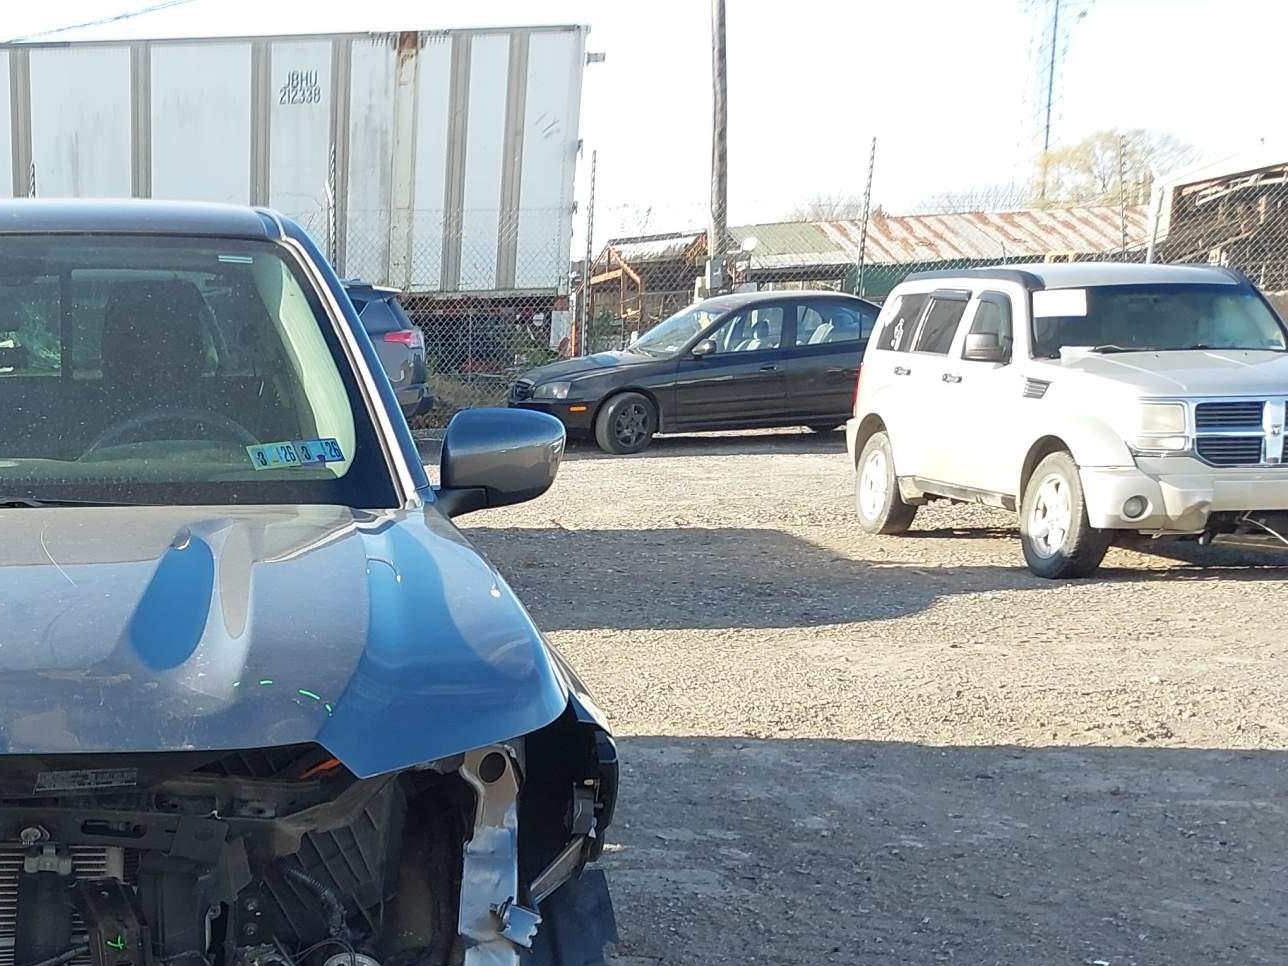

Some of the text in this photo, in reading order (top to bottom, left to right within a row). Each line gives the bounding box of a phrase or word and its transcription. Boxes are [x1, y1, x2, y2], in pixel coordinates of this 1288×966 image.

[285, 70, 318, 89] JBHU
[256, 445, 297, 466] 3 26
[301, 441, 342, 461] 3 26
